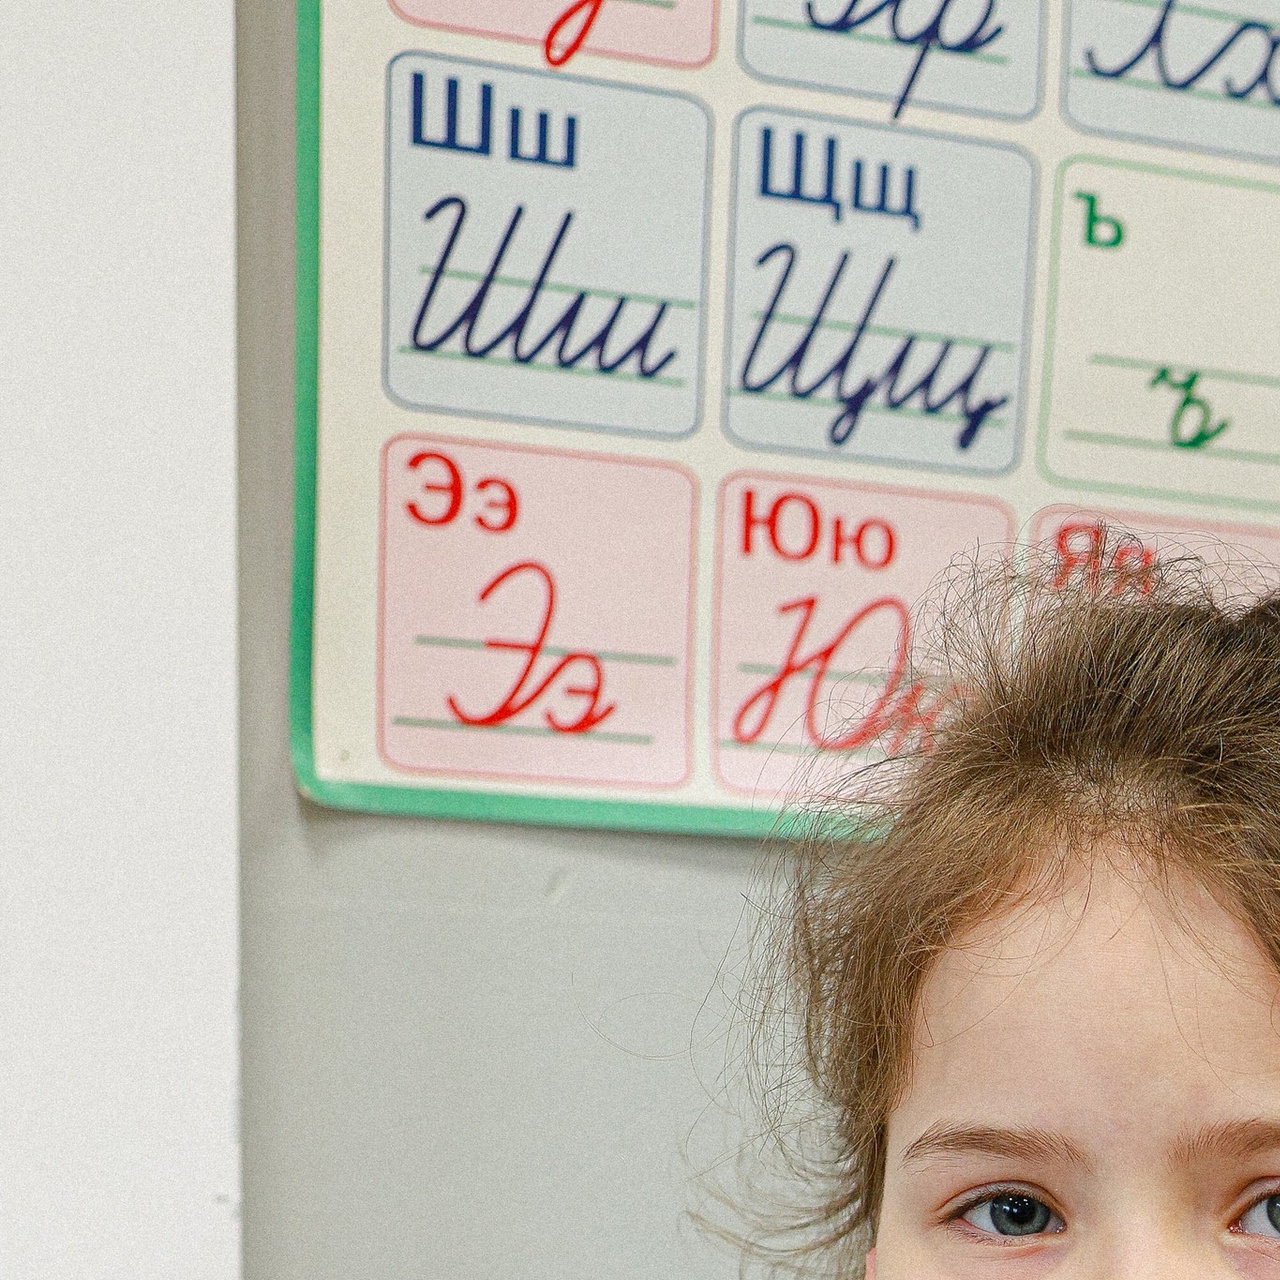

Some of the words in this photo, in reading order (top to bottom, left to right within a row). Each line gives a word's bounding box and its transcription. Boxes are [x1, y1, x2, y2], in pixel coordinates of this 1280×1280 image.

[411, 72, 577, 169] Шш
[759, 126, 921, 231] Щщ
[410, 196, 676, 378] Шш
[740, 243, 1008, 450] Щщ
[404, 449, 520, 533] Ээ
[739, 487, 898, 570] Юю
[446, 560, 616, 735] Ээ
